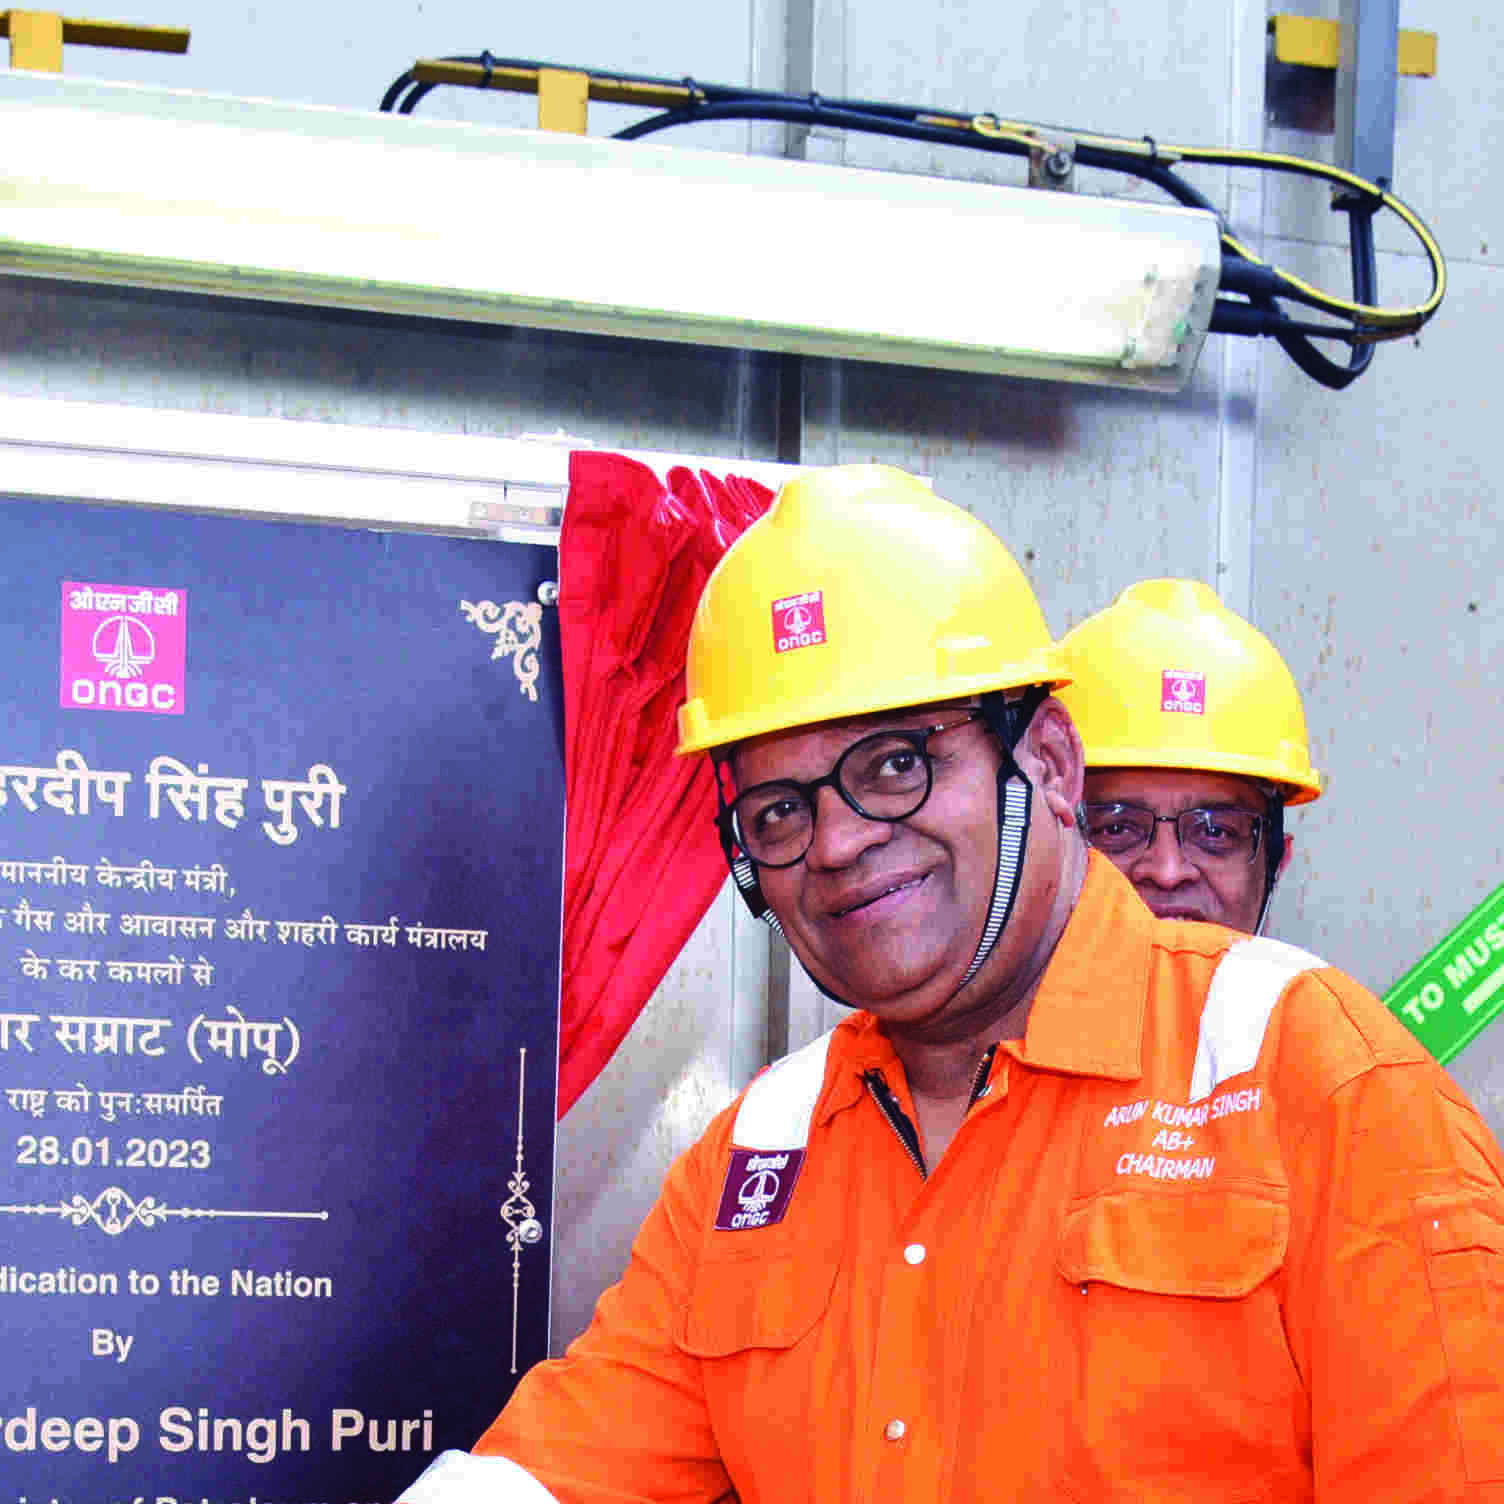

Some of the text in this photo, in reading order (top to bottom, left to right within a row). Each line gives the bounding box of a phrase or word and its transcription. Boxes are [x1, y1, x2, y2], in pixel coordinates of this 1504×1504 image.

[71, 587, 178, 615] ओएनजीसी
[777, 631, 825, 651] ONGC
[72, 675, 175, 709] ONGC
[144, 756, 249, 829] सिंह
[261, 763, 347, 845] पुरी
[95, 857, 177, 892] केन्द्रीय
[182, 863, 235, 897] मंत्री,
[12, 898, 55, 932] गैस
[63, 901, 111, 934] और
[119, 914, 217, 938] आवासन
[223, 908, 271, 942] और
[275, 915, 339, 947] शहरी
[343, 916, 400, 947] कार्य
[404, 921, 489, 951] मंत्रालय
[20, 949, 214, 986] के कर कमलों से
[1401, 981, 1445, 1025] TO
[49, 1015, 172, 1056] सम्राट
[186, 1005, 300, 1075] (मोपू)
[5, 1089, 49, 1118] राष्ट्र
[53, 1082, 92, 1112] को
[1103, 1087, 1262, 1128] ARUN KUMAR SINGH
[16, 1135, 211, 1169] 28.01.2023
[1151, 1129, 1195, 1151] AB+
[1116, 1152, 1216, 1180] CHAIRMAN
[127, 1269, 160, 1295] to
[169, 1269, 220, 1296] the
[231, 1269, 332, 1298] Nation
[92, 1328, 133, 1363] By
[159, 1406, 310, 1464] Singh
[332, 1408, 435, 1452] Puri
